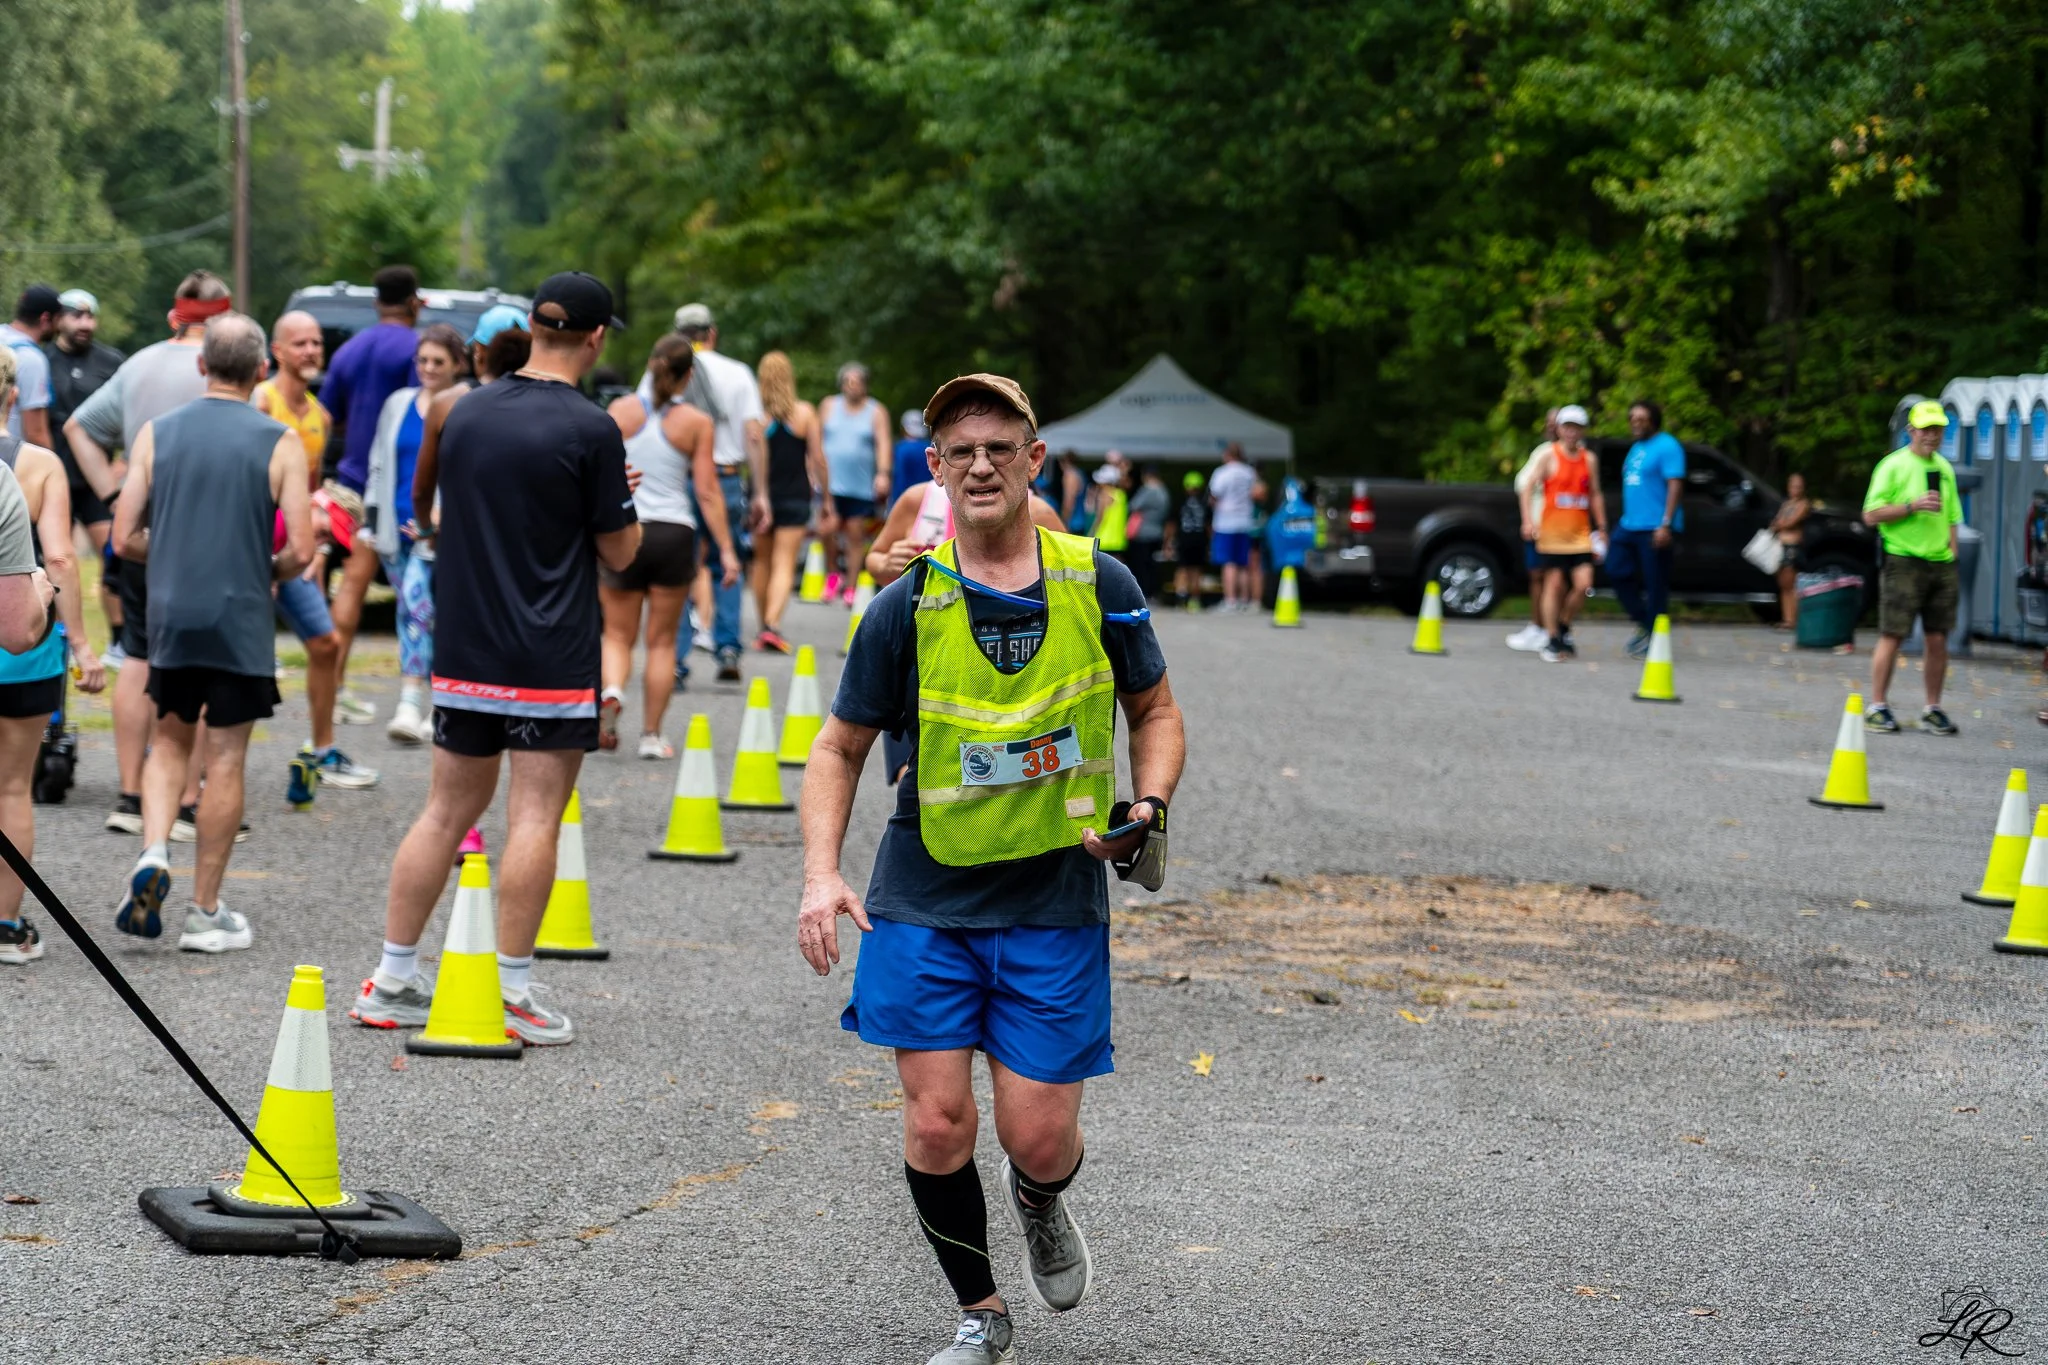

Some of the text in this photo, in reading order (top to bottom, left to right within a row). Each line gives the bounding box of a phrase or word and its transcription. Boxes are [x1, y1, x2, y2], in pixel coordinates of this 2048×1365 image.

[451, 682, 518, 700] ALTRA
[1030, 735, 1053, 749] Danny
[1021, 744, 1061, 778] 38
